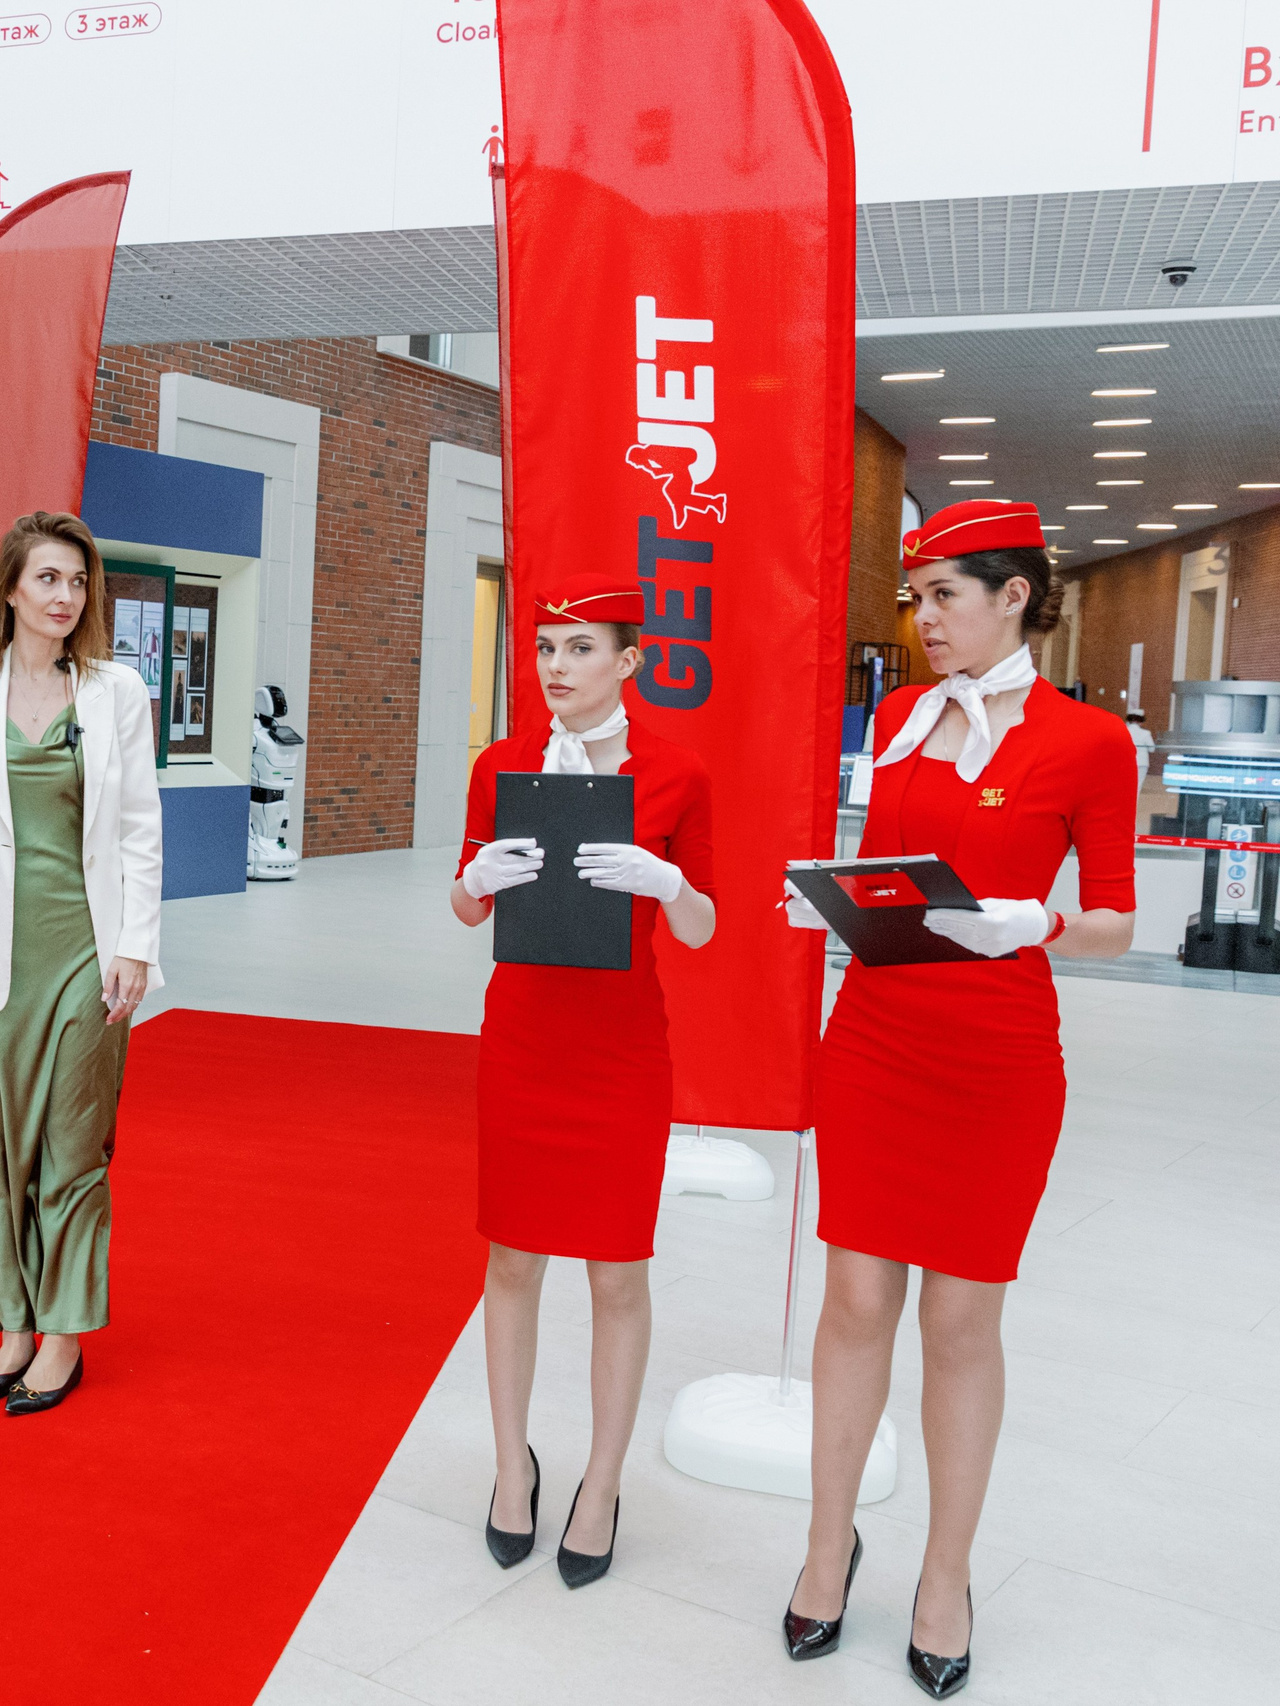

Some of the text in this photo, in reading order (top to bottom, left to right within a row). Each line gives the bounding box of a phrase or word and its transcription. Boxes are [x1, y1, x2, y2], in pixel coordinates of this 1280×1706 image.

[77, 13, 149, 33] 3 этаж
[1240, 109, 1280, 133] En
[635, 295, 717, 710] GET JET
[981, 788, 1004, 798] GET
[982, 797, 1006, 806] JET
